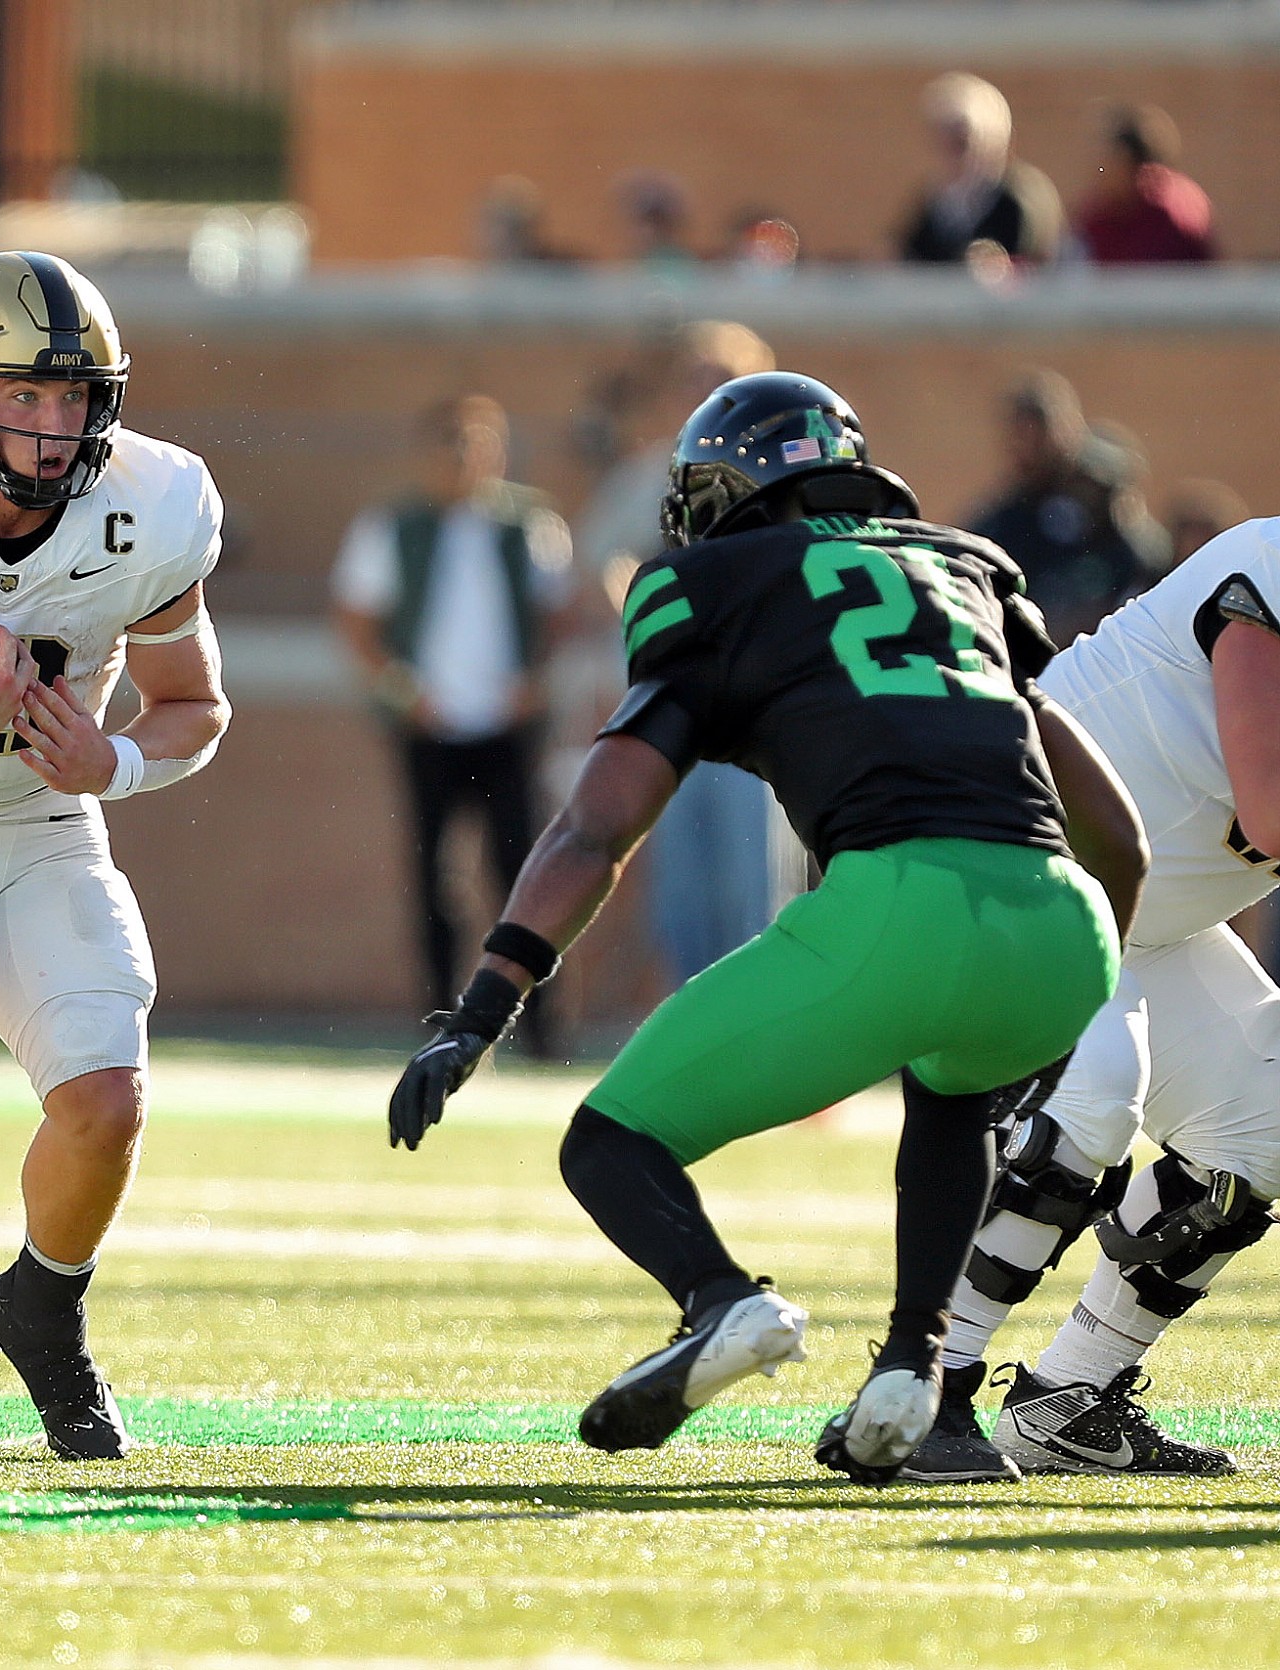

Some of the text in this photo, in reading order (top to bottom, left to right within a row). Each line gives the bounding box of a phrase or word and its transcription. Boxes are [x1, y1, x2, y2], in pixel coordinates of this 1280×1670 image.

[51, 354, 83, 366] ARMY
[104, 510, 136, 555] C
[801, 540, 1019, 704] 21
